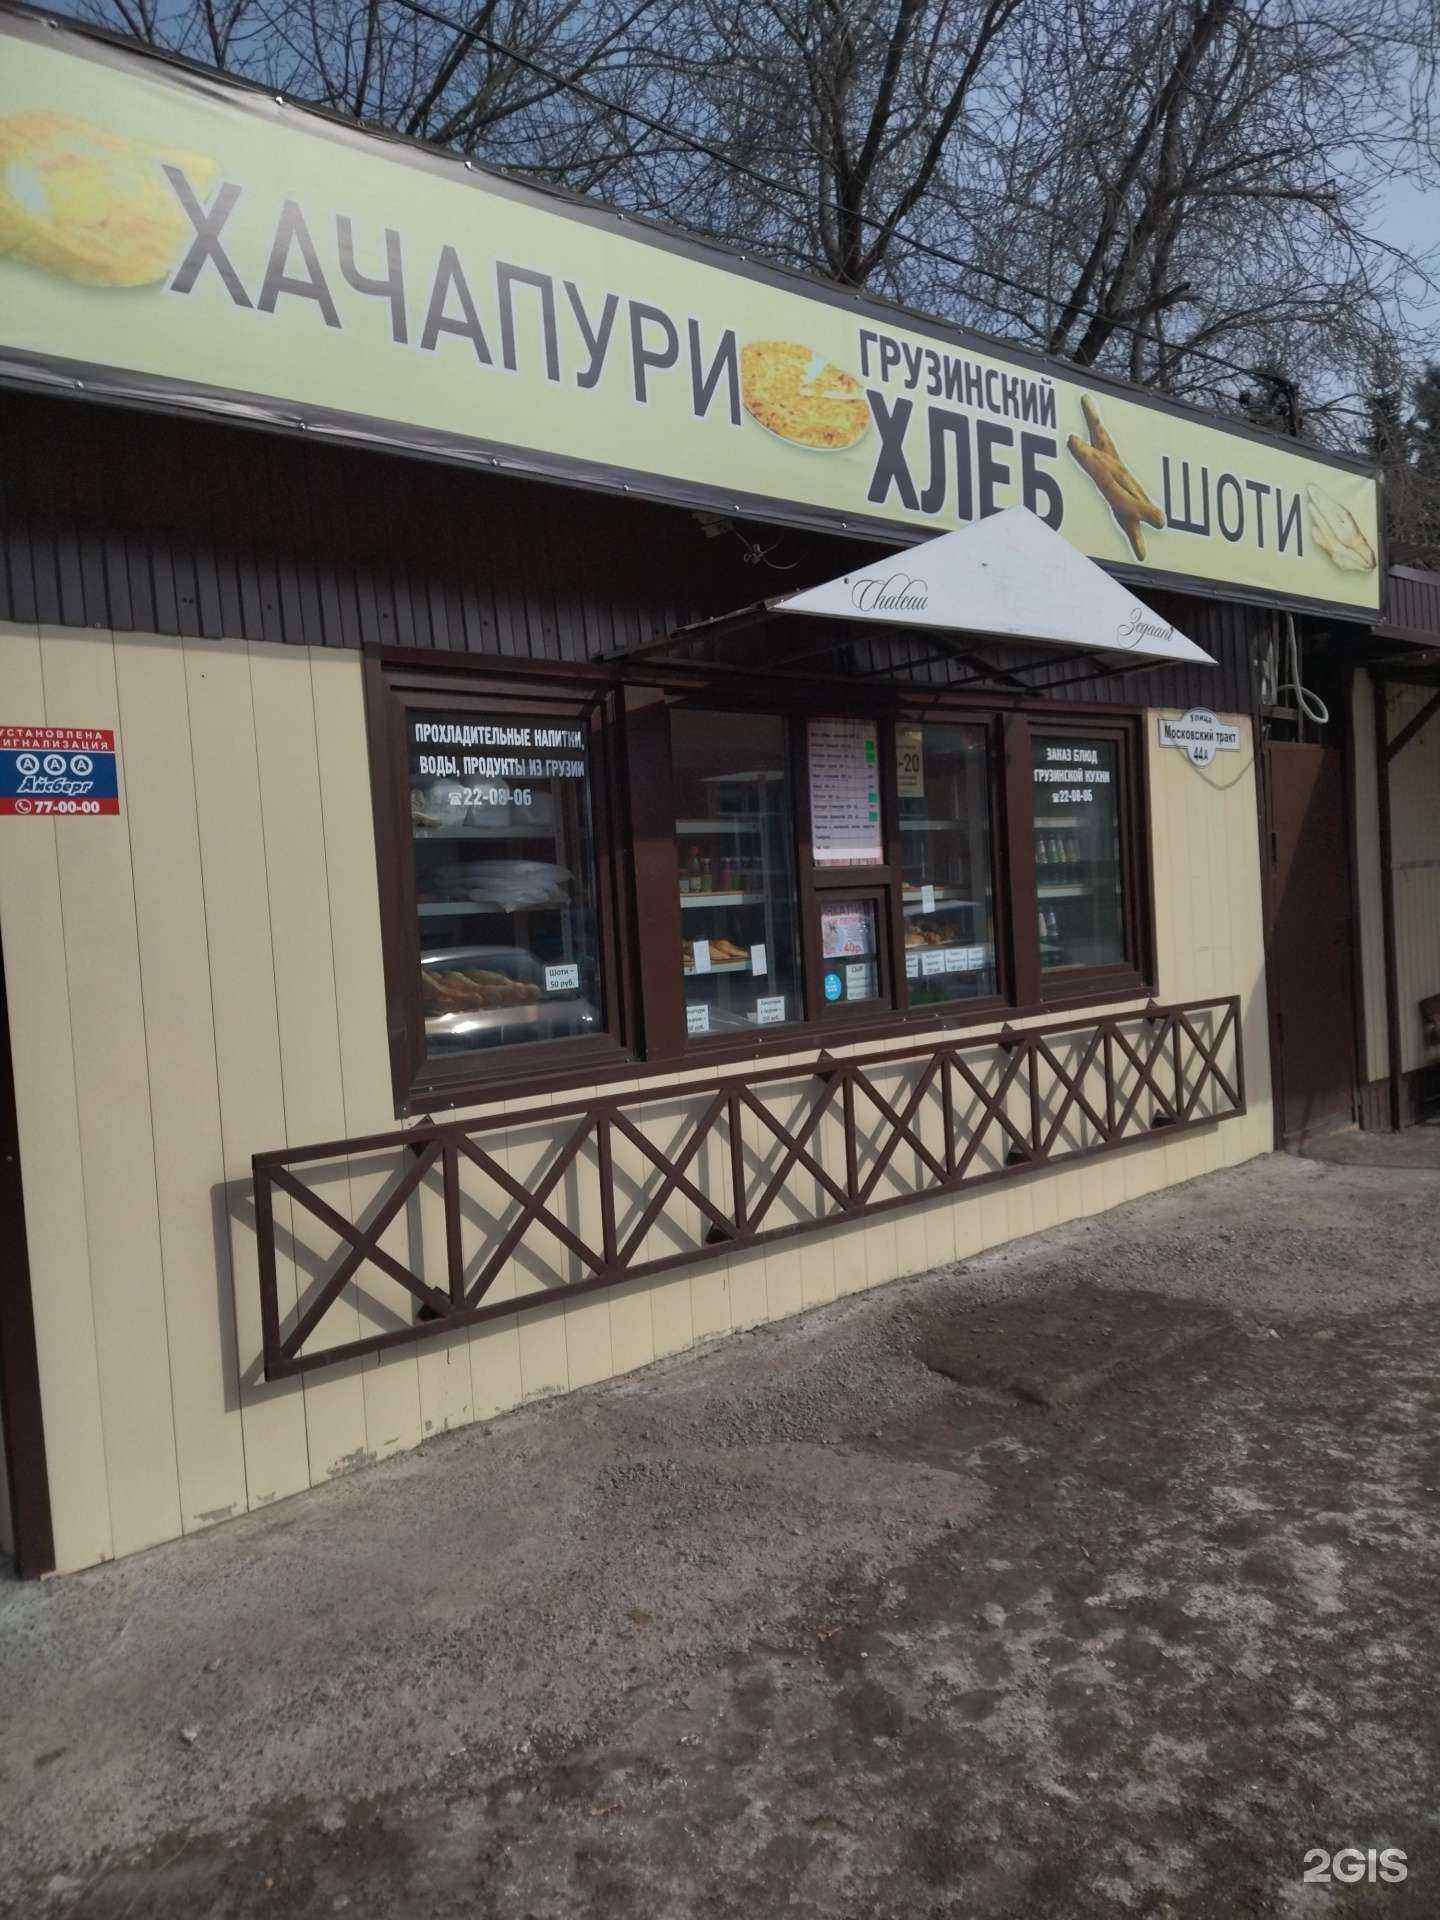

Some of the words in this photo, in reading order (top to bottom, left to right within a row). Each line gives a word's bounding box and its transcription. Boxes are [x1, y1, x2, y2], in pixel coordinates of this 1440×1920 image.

[161, 163, 742, 426] ХАЧАПУРИ
[859, 329, 1057, 429] ГРУЗИНСКИЙ
[866, 389, 1064, 532] ХЛЕБ
[1162, 456, 1303, 557] ШОТИ
[852, 573, 928, 612] Chateau
[0, 738, 109, 750] ИГНАЛИЗАЦИЯ
[415, 723, 531, 747] ПРОХЛАДИТЕЛЬНЫЕ
[1164, 725, 1214, 741] Московский
[1216, 733, 1237, 744] тракт
[419, 755, 460, 777] ВОДЫ,
[463, 756, 526, 778] ПРОДУКТЫ
[529, 759, 543, 776] ИЗ
[546, 760, 585, 778] ГРУЗИИ
[1046, 747, 1072, 761] ЗАКАЗ
[1073, 749, 1098, 764] БЛЮД
[16, 776, 94, 796] Айсберг
[34, 801, 100, 813] 77-00-00
